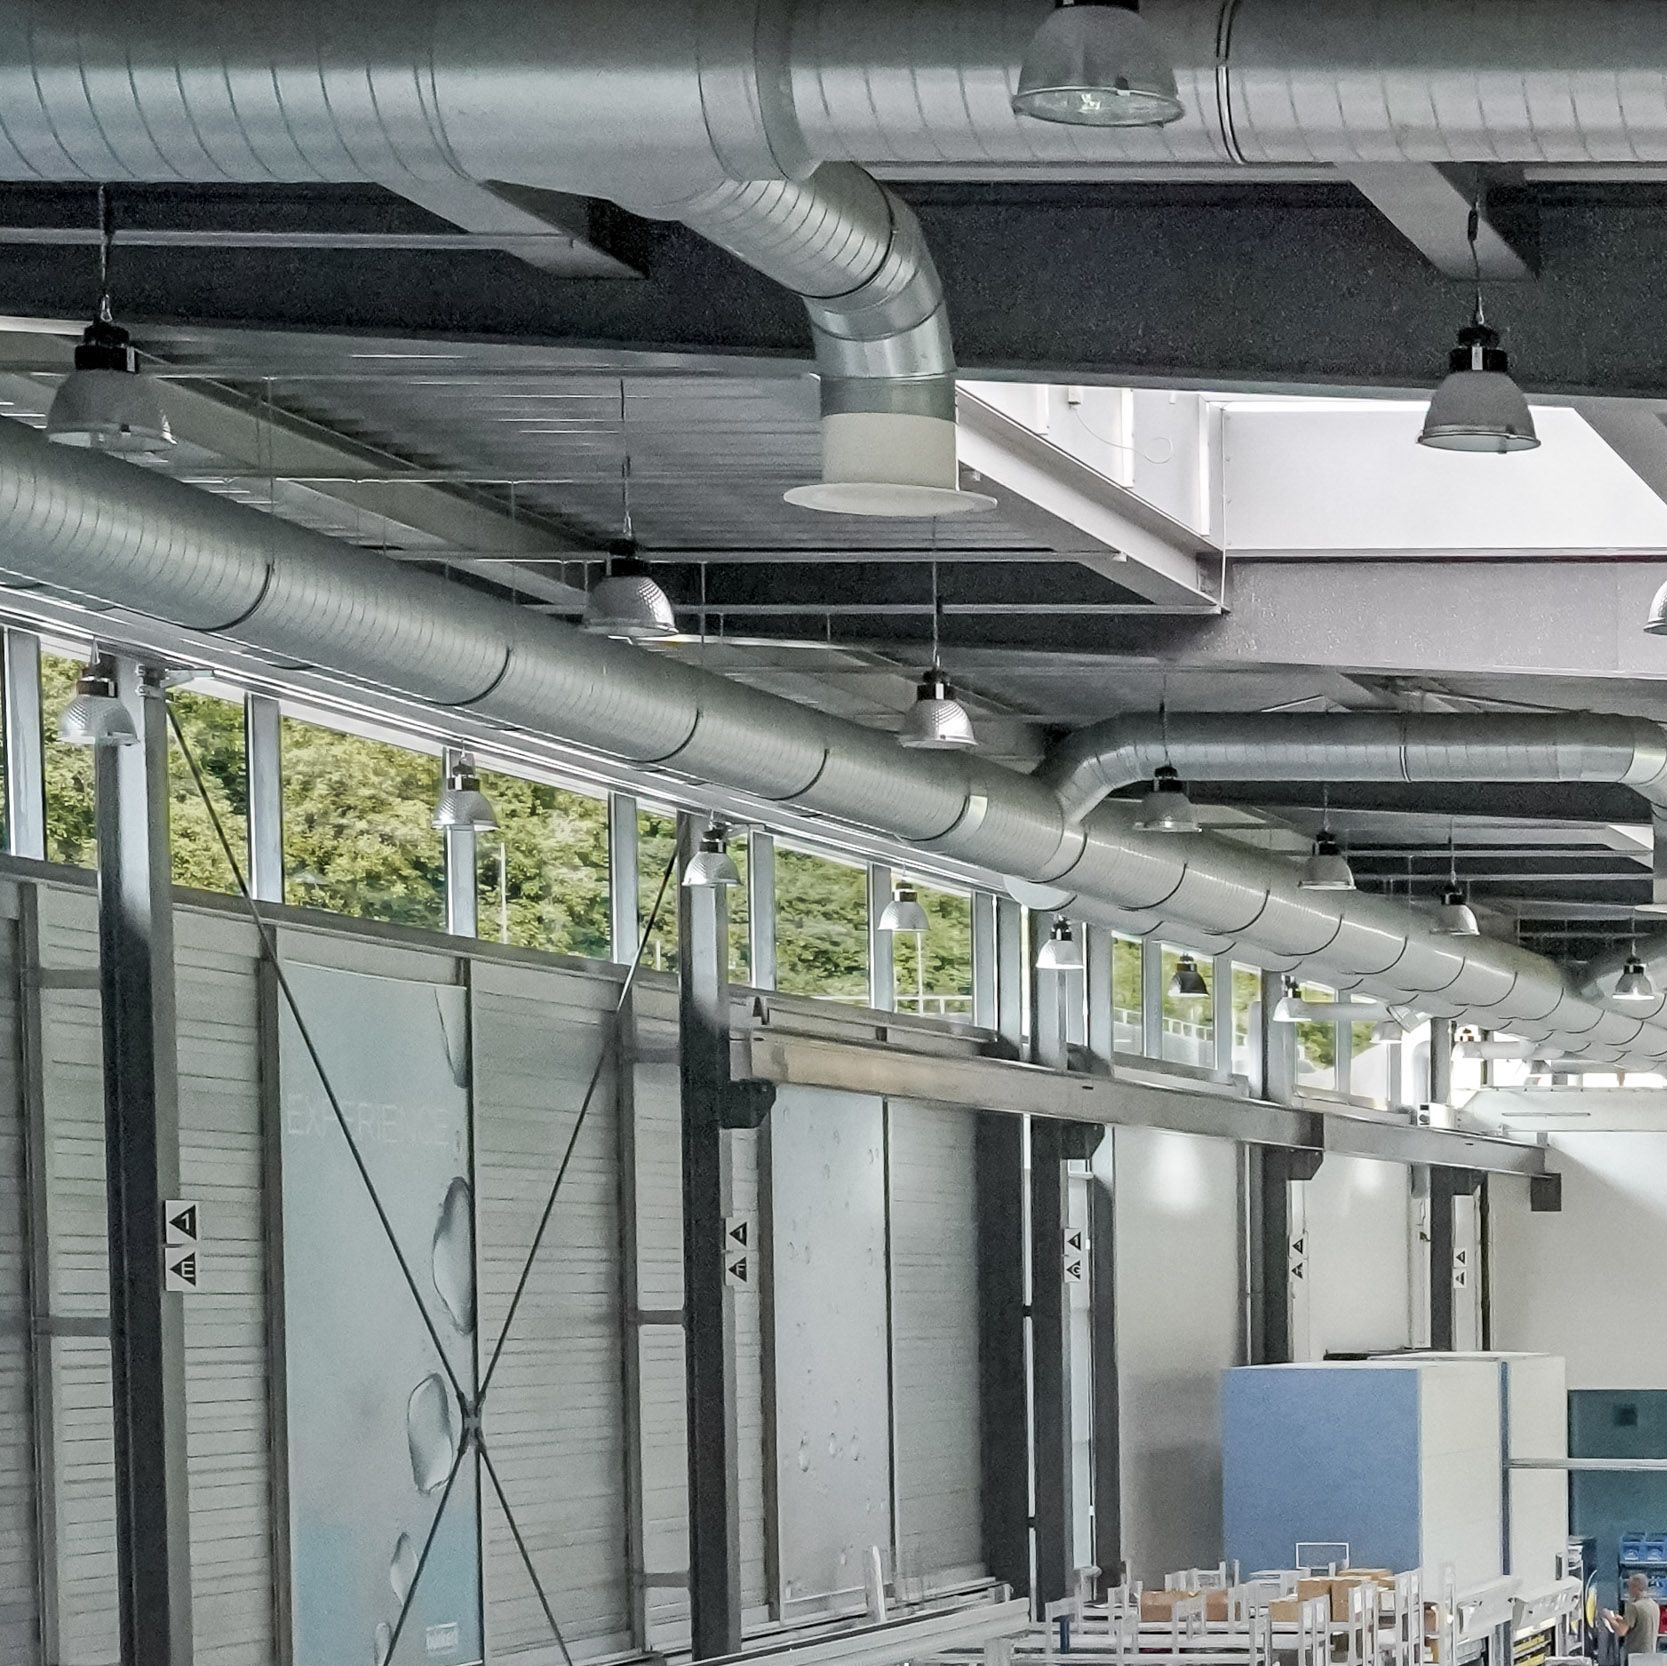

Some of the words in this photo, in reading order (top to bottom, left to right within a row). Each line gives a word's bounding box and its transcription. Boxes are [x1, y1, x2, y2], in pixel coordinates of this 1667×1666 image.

[181, 1213, 190, 1230] 1
[736, 1228, 743, 1240] 1
[181, 1261, 194, 1277] E
[736, 1264, 745, 1276] F
